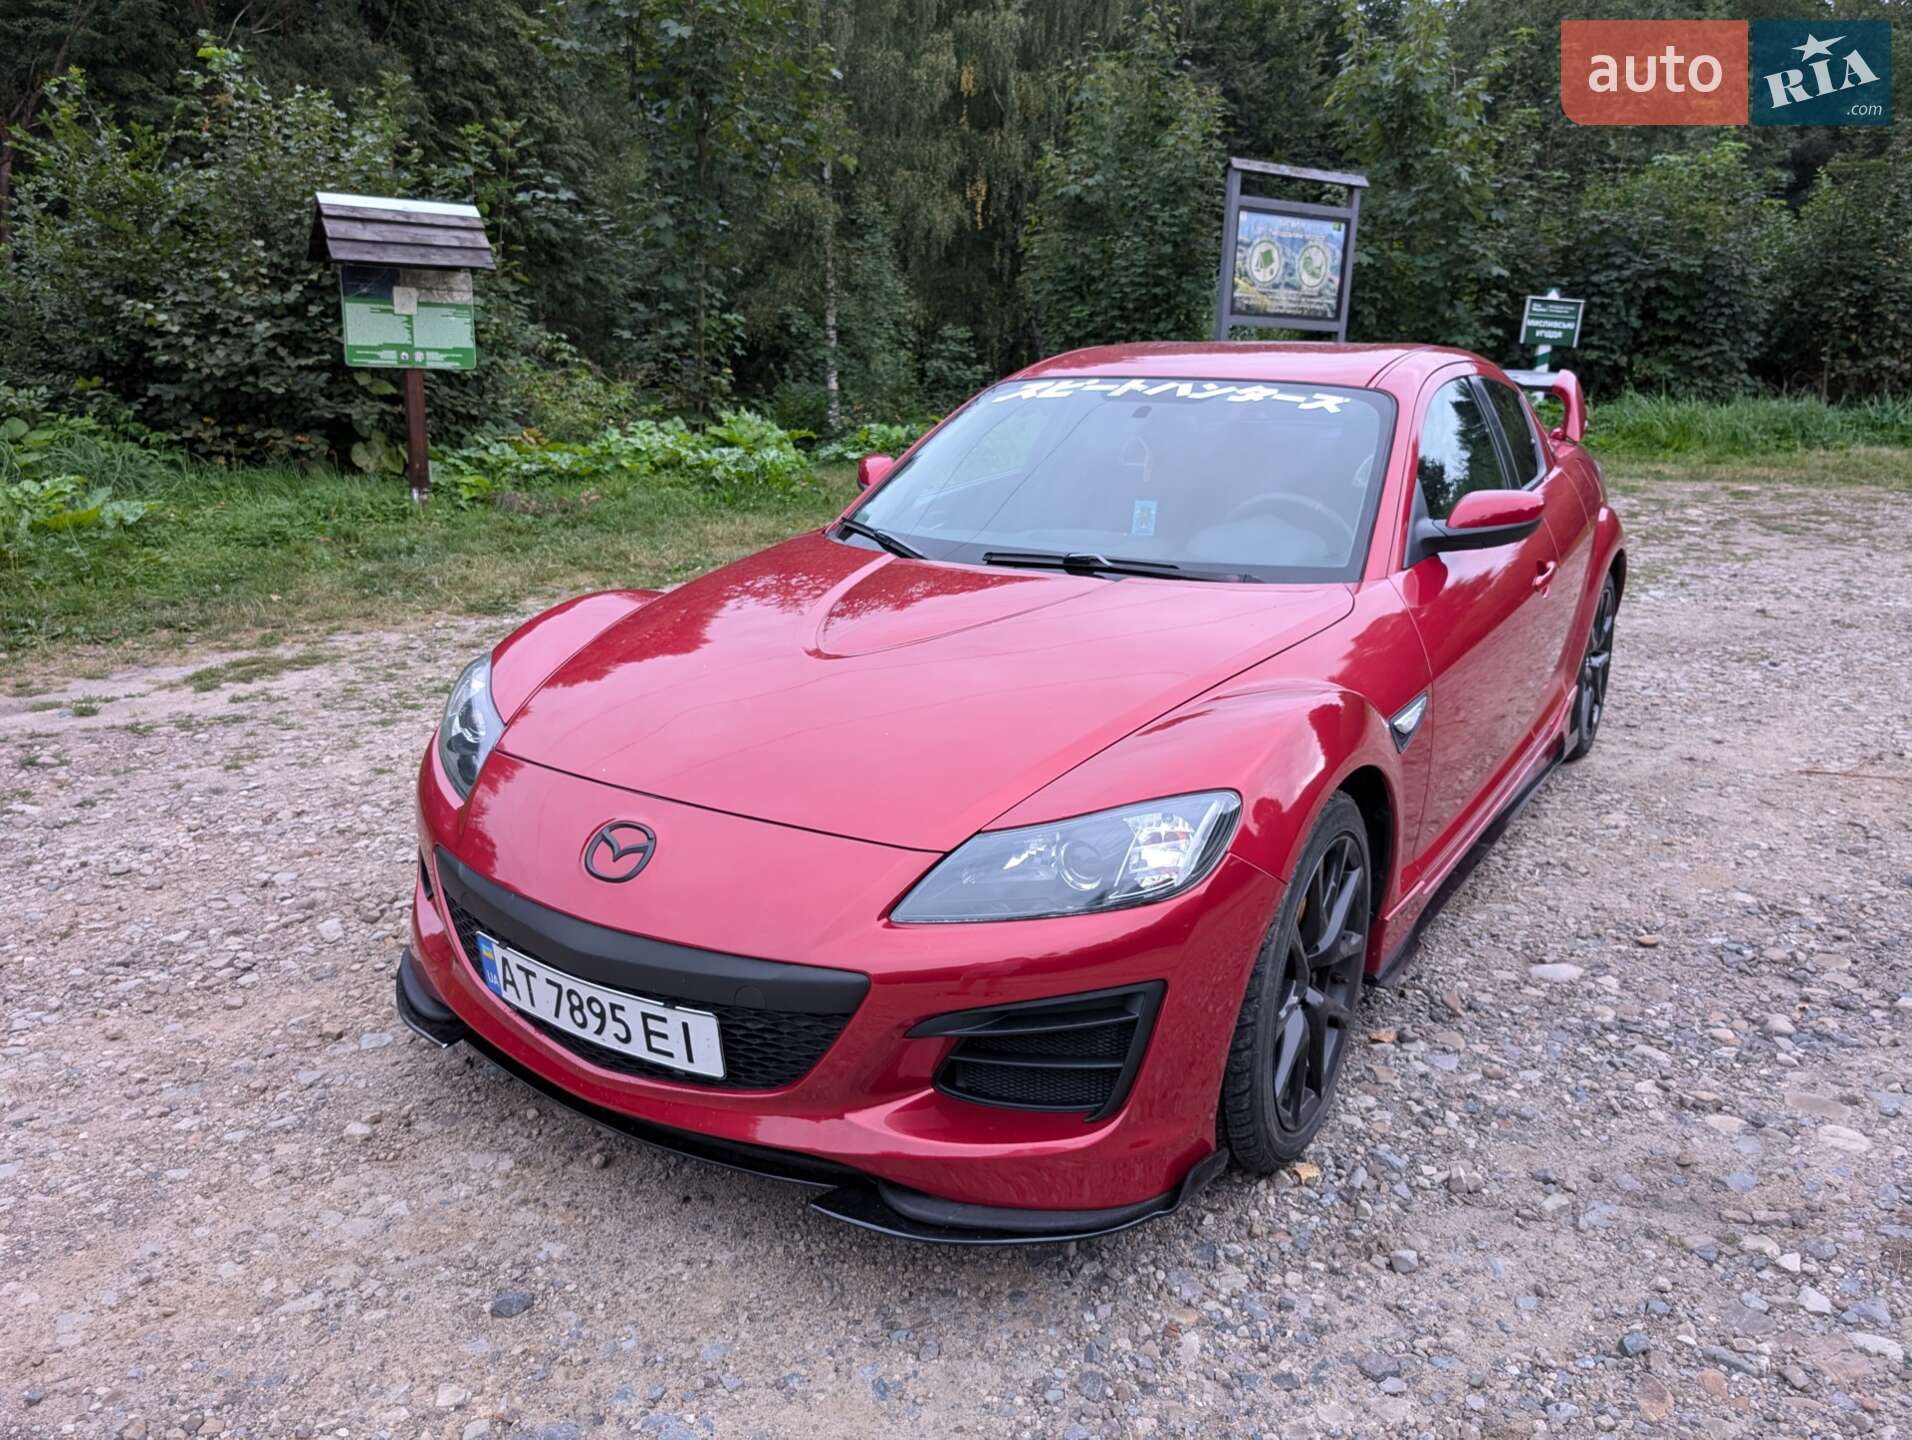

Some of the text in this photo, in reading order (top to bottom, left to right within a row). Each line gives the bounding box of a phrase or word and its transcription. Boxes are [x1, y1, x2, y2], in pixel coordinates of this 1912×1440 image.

[486, 970, 500, 987] UA
[501, 955, 695, 1064] AT 7895 EI
